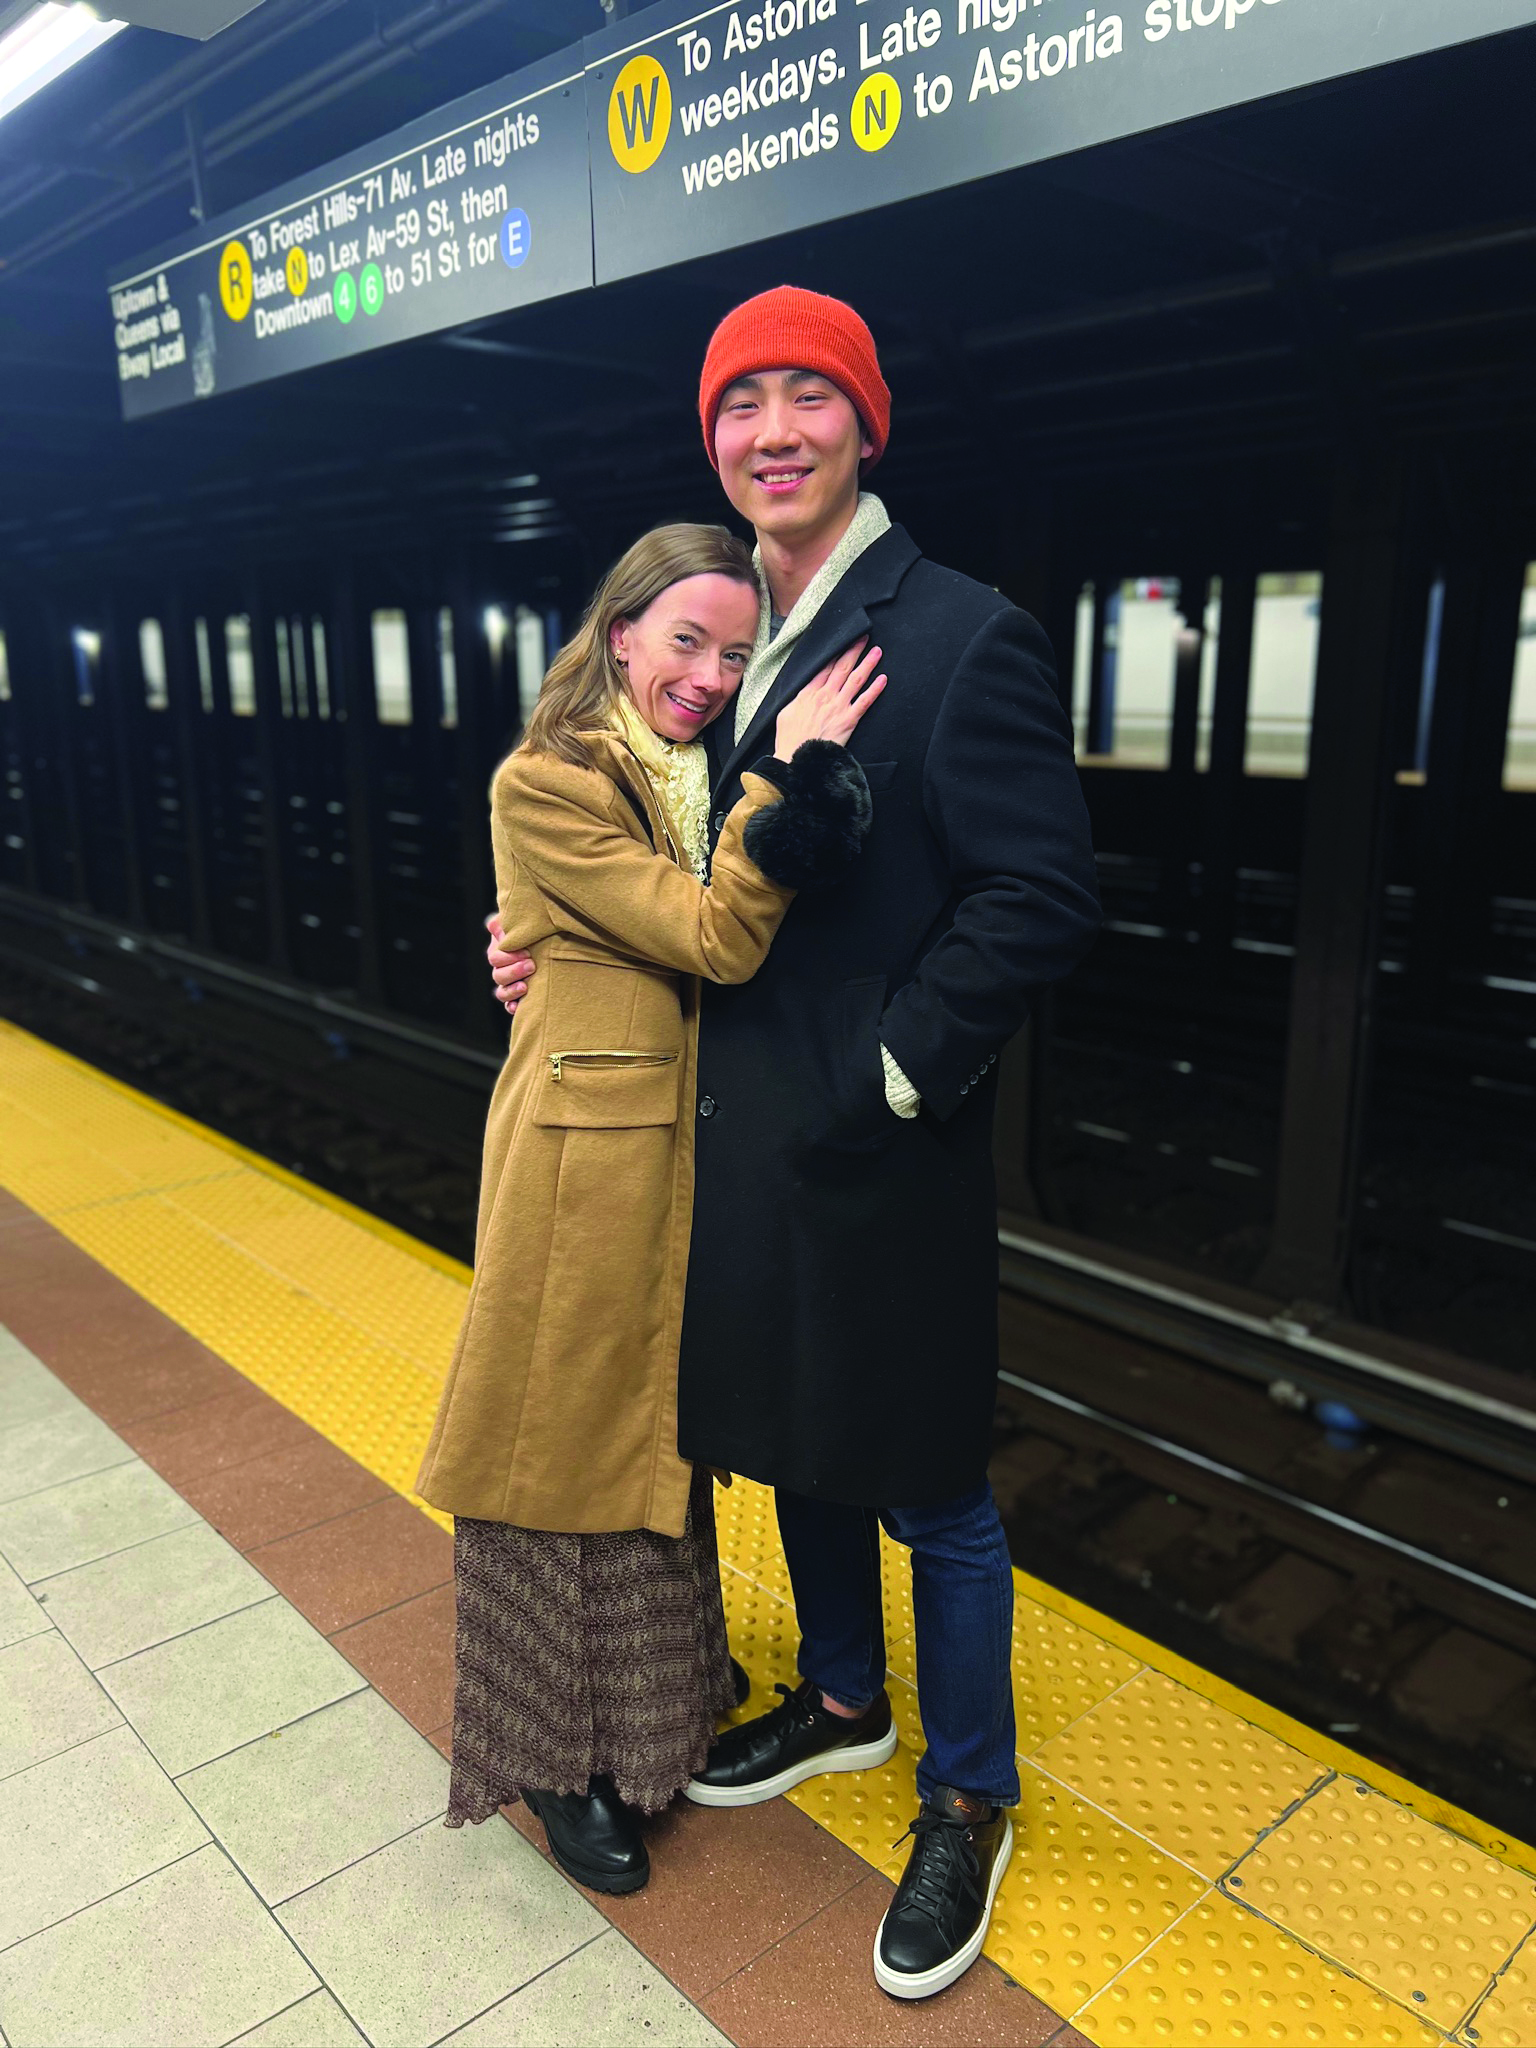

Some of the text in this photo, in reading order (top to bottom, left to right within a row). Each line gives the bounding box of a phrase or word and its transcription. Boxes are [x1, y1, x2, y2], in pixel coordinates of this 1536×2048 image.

[677, 30, 712, 76] To
[680, 47, 846, 136] weekdays.
[859, 6, 942, 70] Late
[681, 0, 1281, 195] weekends N to Astoria stop
[616, 75, 660, 149] W
[248, 112, 540, 261] To Forest Hills-71 Av. Late nights
[253, 266, 286, 300] take
[308, 251, 326, 281] to
[329, 239, 361, 273] Lex
[366, 208, 421, 260] Av-59
[427, 198, 455, 238] St,
[461, 183, 508, 224] then
[228, 260, 244, 303] R
[254, 292, 333, 339] Downtown
[385, 264, 405, 295] to
[411, 248, 432, 287] 51
[438, 240, 461, 278] St
[468, 232, 498, 267] for
